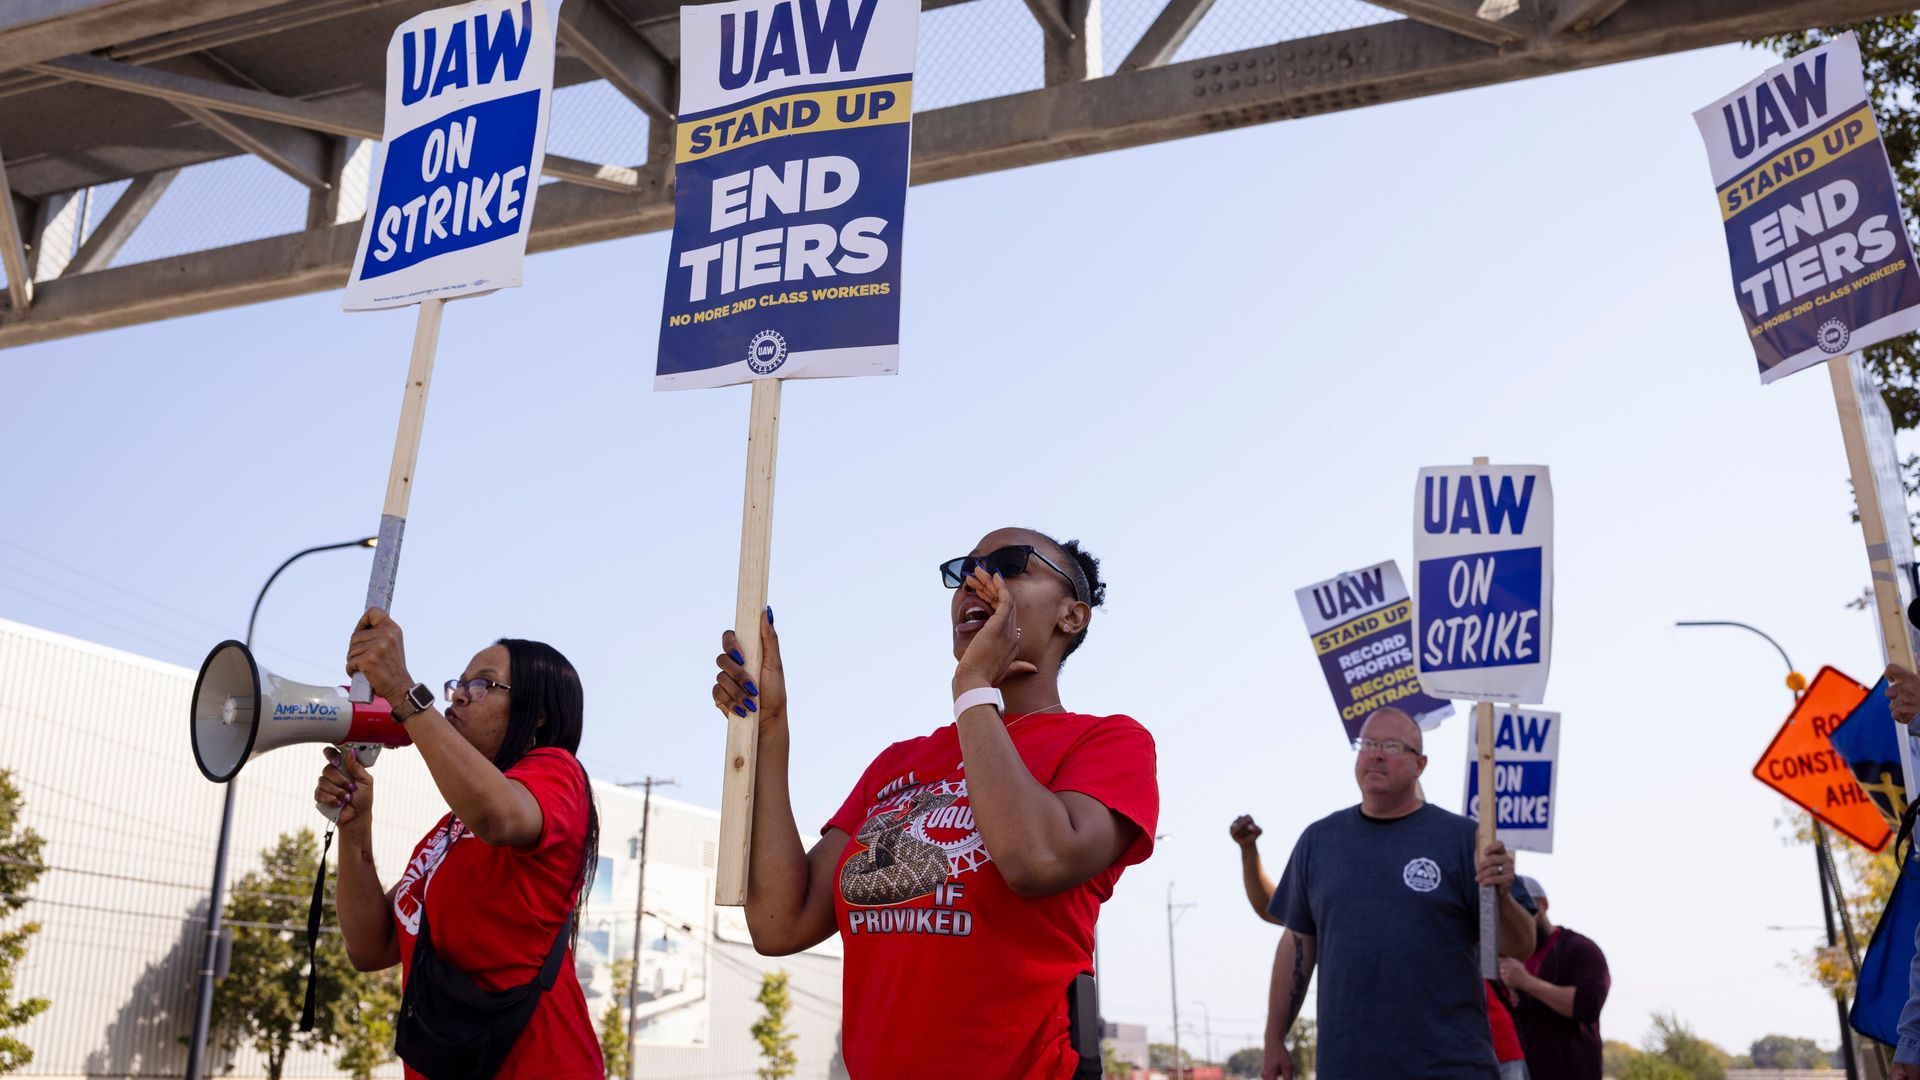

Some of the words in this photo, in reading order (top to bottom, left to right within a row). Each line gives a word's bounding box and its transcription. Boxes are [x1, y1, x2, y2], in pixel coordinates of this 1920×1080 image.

[402, 0, 532, 106] UAW
[719, 0, 878, 90] UAW
[689, 100, 820, 154] STAND
[836, 91, 896, 123] UP
[1723, 52, 1828, 159] UAW
[422, 116, 477, 182] ON
[1726, 147, 1815, 212] STAND
[1822, 119, 1864, 156] UP
[373, 165, 527, 262] STRIKE
[710, 155, 860, 233] END
[1750, 179, 1859, 264] END
[679, 216, 889, 303] TIERS
[1740, 214, 1897, 317] TIERS
[669, 314, 691, 327] NO
[694, 304, 730, 323] MORE
[732, 298, 757, 315] 2ND
[759, 290, 808, 308] CLASS
[812, 283, 891, 301] WORKERS
[1750, 325, 1764, 337] NO
[1764, 310, 1792, 331] MORE
[1793, 301, 1813, 317] 2ND
[1814, 285, 1851, 306] CLASS
[1851, 259, 1907, 291] WORKERS
[757, 345, 774, 356] UAW
[1424, 475, 1536, 535] UAW
[1313, 568, 1386, 621] UAW
[1448, 556, 1495, 609] ON
[1318, 618, 1380, 650] STAND
[1384, 606, 1409, 624] UP
[1424, 609, 1538, 667] STRIKE
[1338, 634, 1407, 670] RECORD
[1343, 647, 1413, 684] PROFITS
[1342, 680, 1421, 721] CONTRAC
[1350, 664, 1416, 700] RECORD
[1475, 713, 1551, 753] AW
[1811, 713, 1841, 739] RO
[876, 771, 921, 801] WILL
[1494, 764, 1523, 793] ON
[1768, 749, 1849, 782] CONST
[1469, 795, 1549, 824] SRIKE
[1825, 782, 1870, 808] AHE
[926, 805, 976, 831] UAW
[934, 882, 966, 907] IF
[848, 907, 973, 936] PROVOKED
